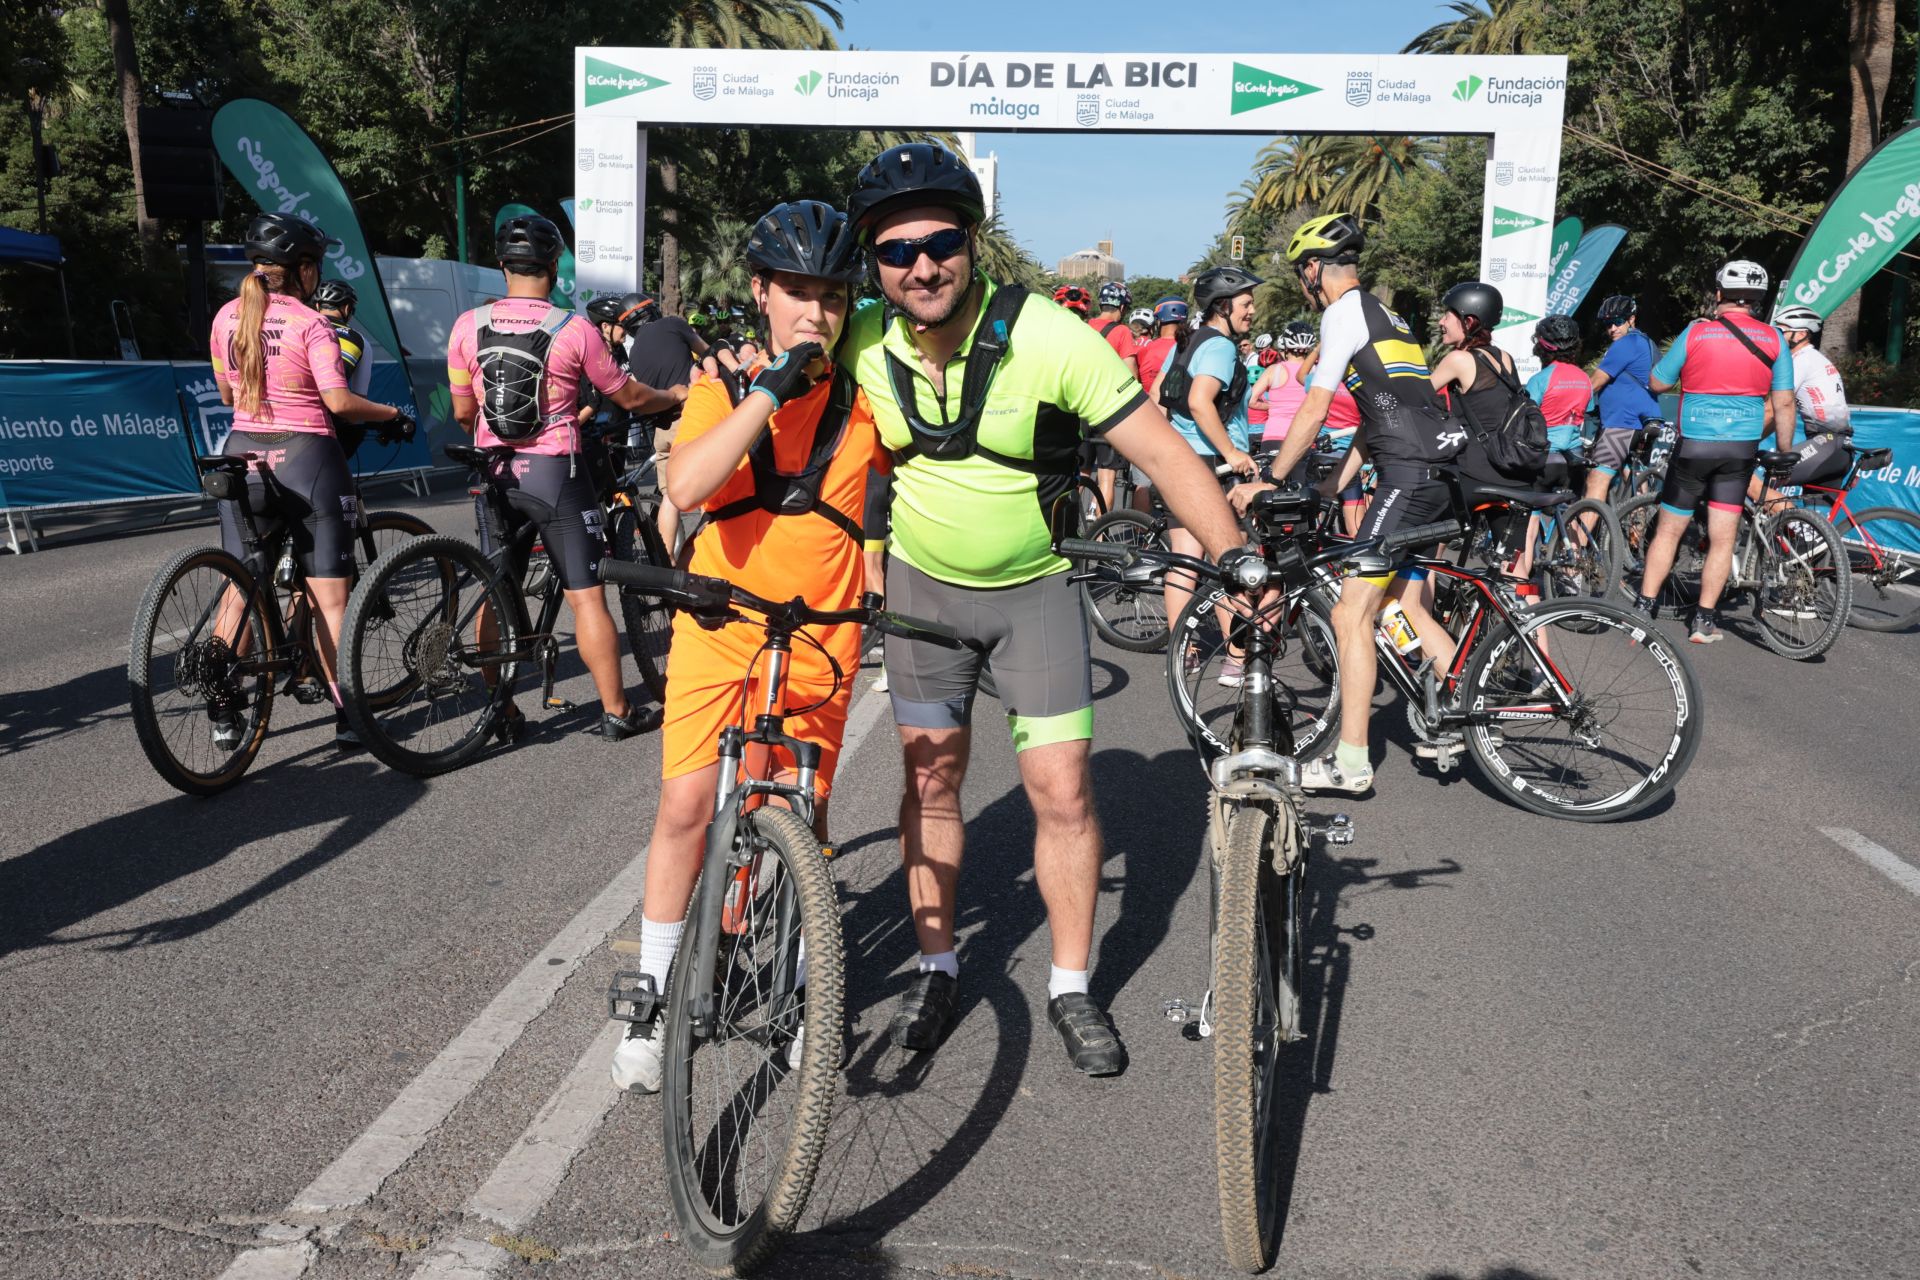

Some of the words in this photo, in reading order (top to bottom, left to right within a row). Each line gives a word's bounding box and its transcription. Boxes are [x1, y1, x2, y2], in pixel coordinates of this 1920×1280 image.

[930, 54, 995, 88] DÍA
[1006, 62, 1054, 88] DE
[1066, 62, 1113, 89] LA
[1125, 61, 1198, 88] BICI
[722, 73, 759, 84] Ciudad
[827, 72, 899, 85] Fundación
[1487, 76, 1565, 91] Fundación
[1245, 82, 1267, 95] Corte
[1266, 79, 1299, 97] Inglés
[1377, 79, 1416, 90] Ciudad
[722, 86, 736, 96] de
[738, 85, 774, 98] Málaga
[827, 86, 879, 101] Unicaja
[1376, 92, 1390, 102] de
[1393, 91, 1432, 104] Málaga
[1487, 91, 1542, 108] Unicaja
[1105, 98, 1140, 109] Ciudad
[1105, 110, 1118, 120] de
[1119, 110, 1154, 121] Málaga
[598, 152, 623, 160] Ciudad
[598, 161, 607, 169] de
[608, 161, 634, 169] Málaga
[1517, 165, 1546, 174] Ciudad
[1517, 175, 1527, 183] de
[1528, 175, 1555, 184] Málaga
[595, 199, 634, 207] Fundación
[595, 206, 623, 215] Unicaja
[608, 253, 633, 262] Málaga
[1817, 231, 1877, 284] Corte
[1511, 262, 1537, 270] Ciudad
[1521, 271, 1547, 280] Málaga
[229, 313, 287, 326] cadale
[70, 414, 99, 437] de
[101, 413, 179, 440] Málaga
